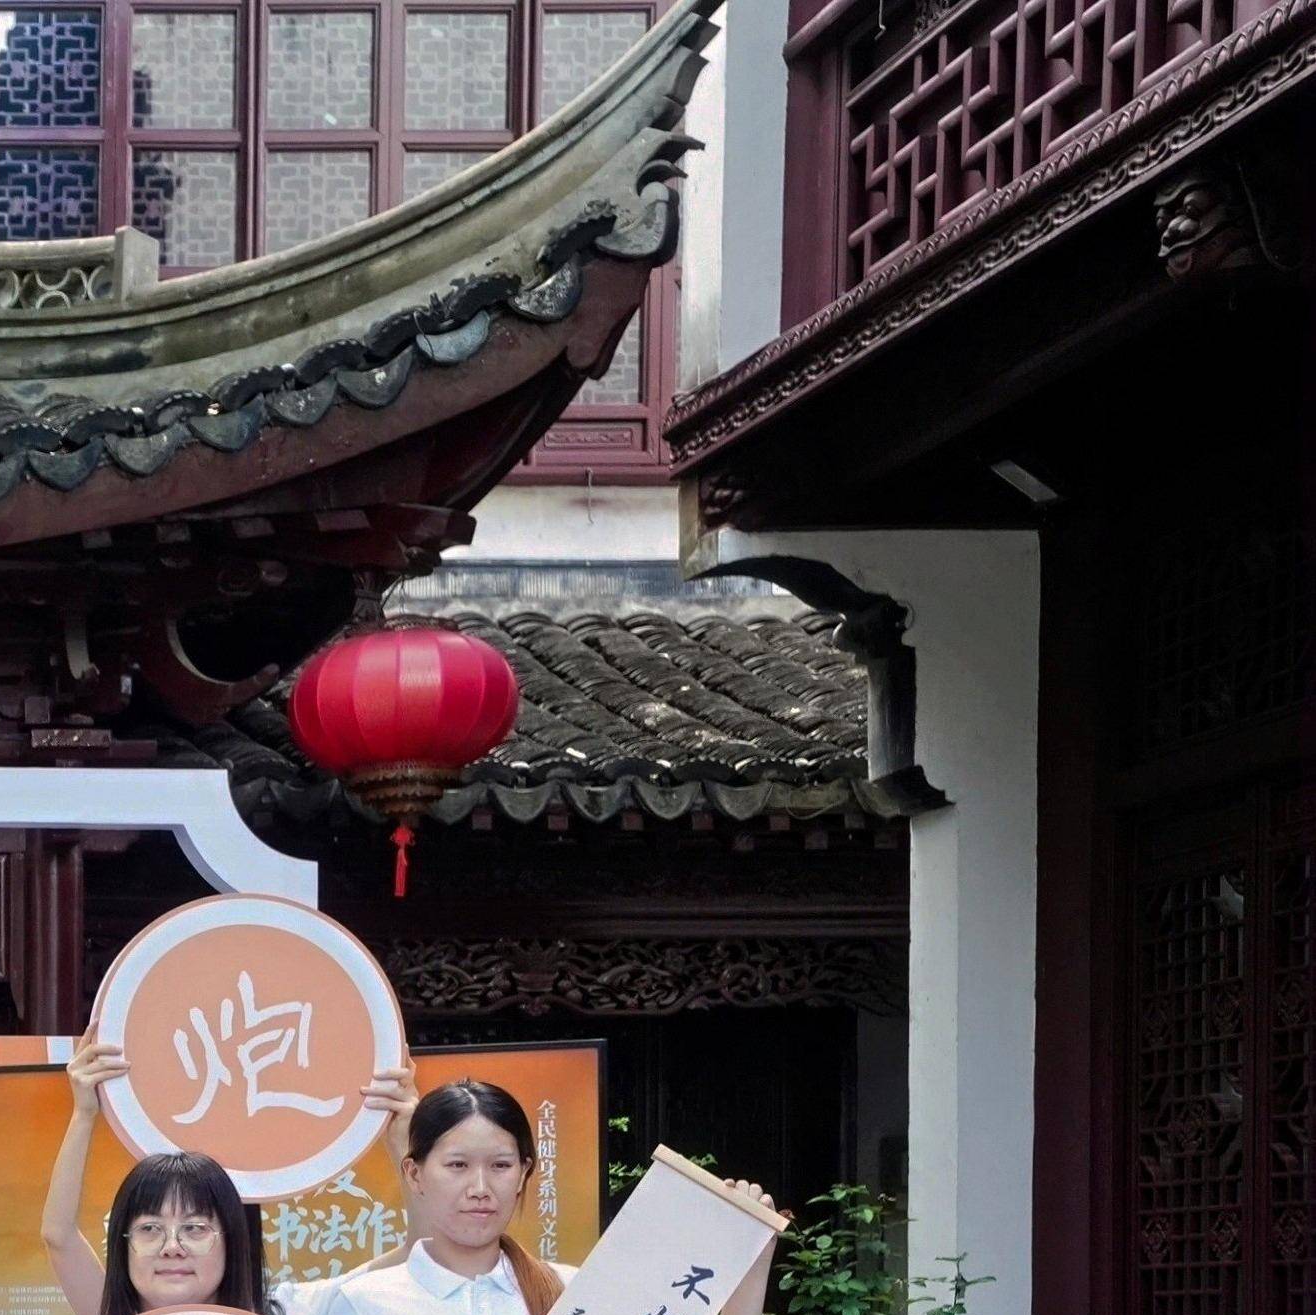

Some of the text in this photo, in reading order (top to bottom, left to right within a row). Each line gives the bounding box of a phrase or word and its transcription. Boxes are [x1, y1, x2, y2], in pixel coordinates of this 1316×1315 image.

[171, 970, 343, 1126] 炮
[536, 1099, 558, 1263] 全民健身系列文化
